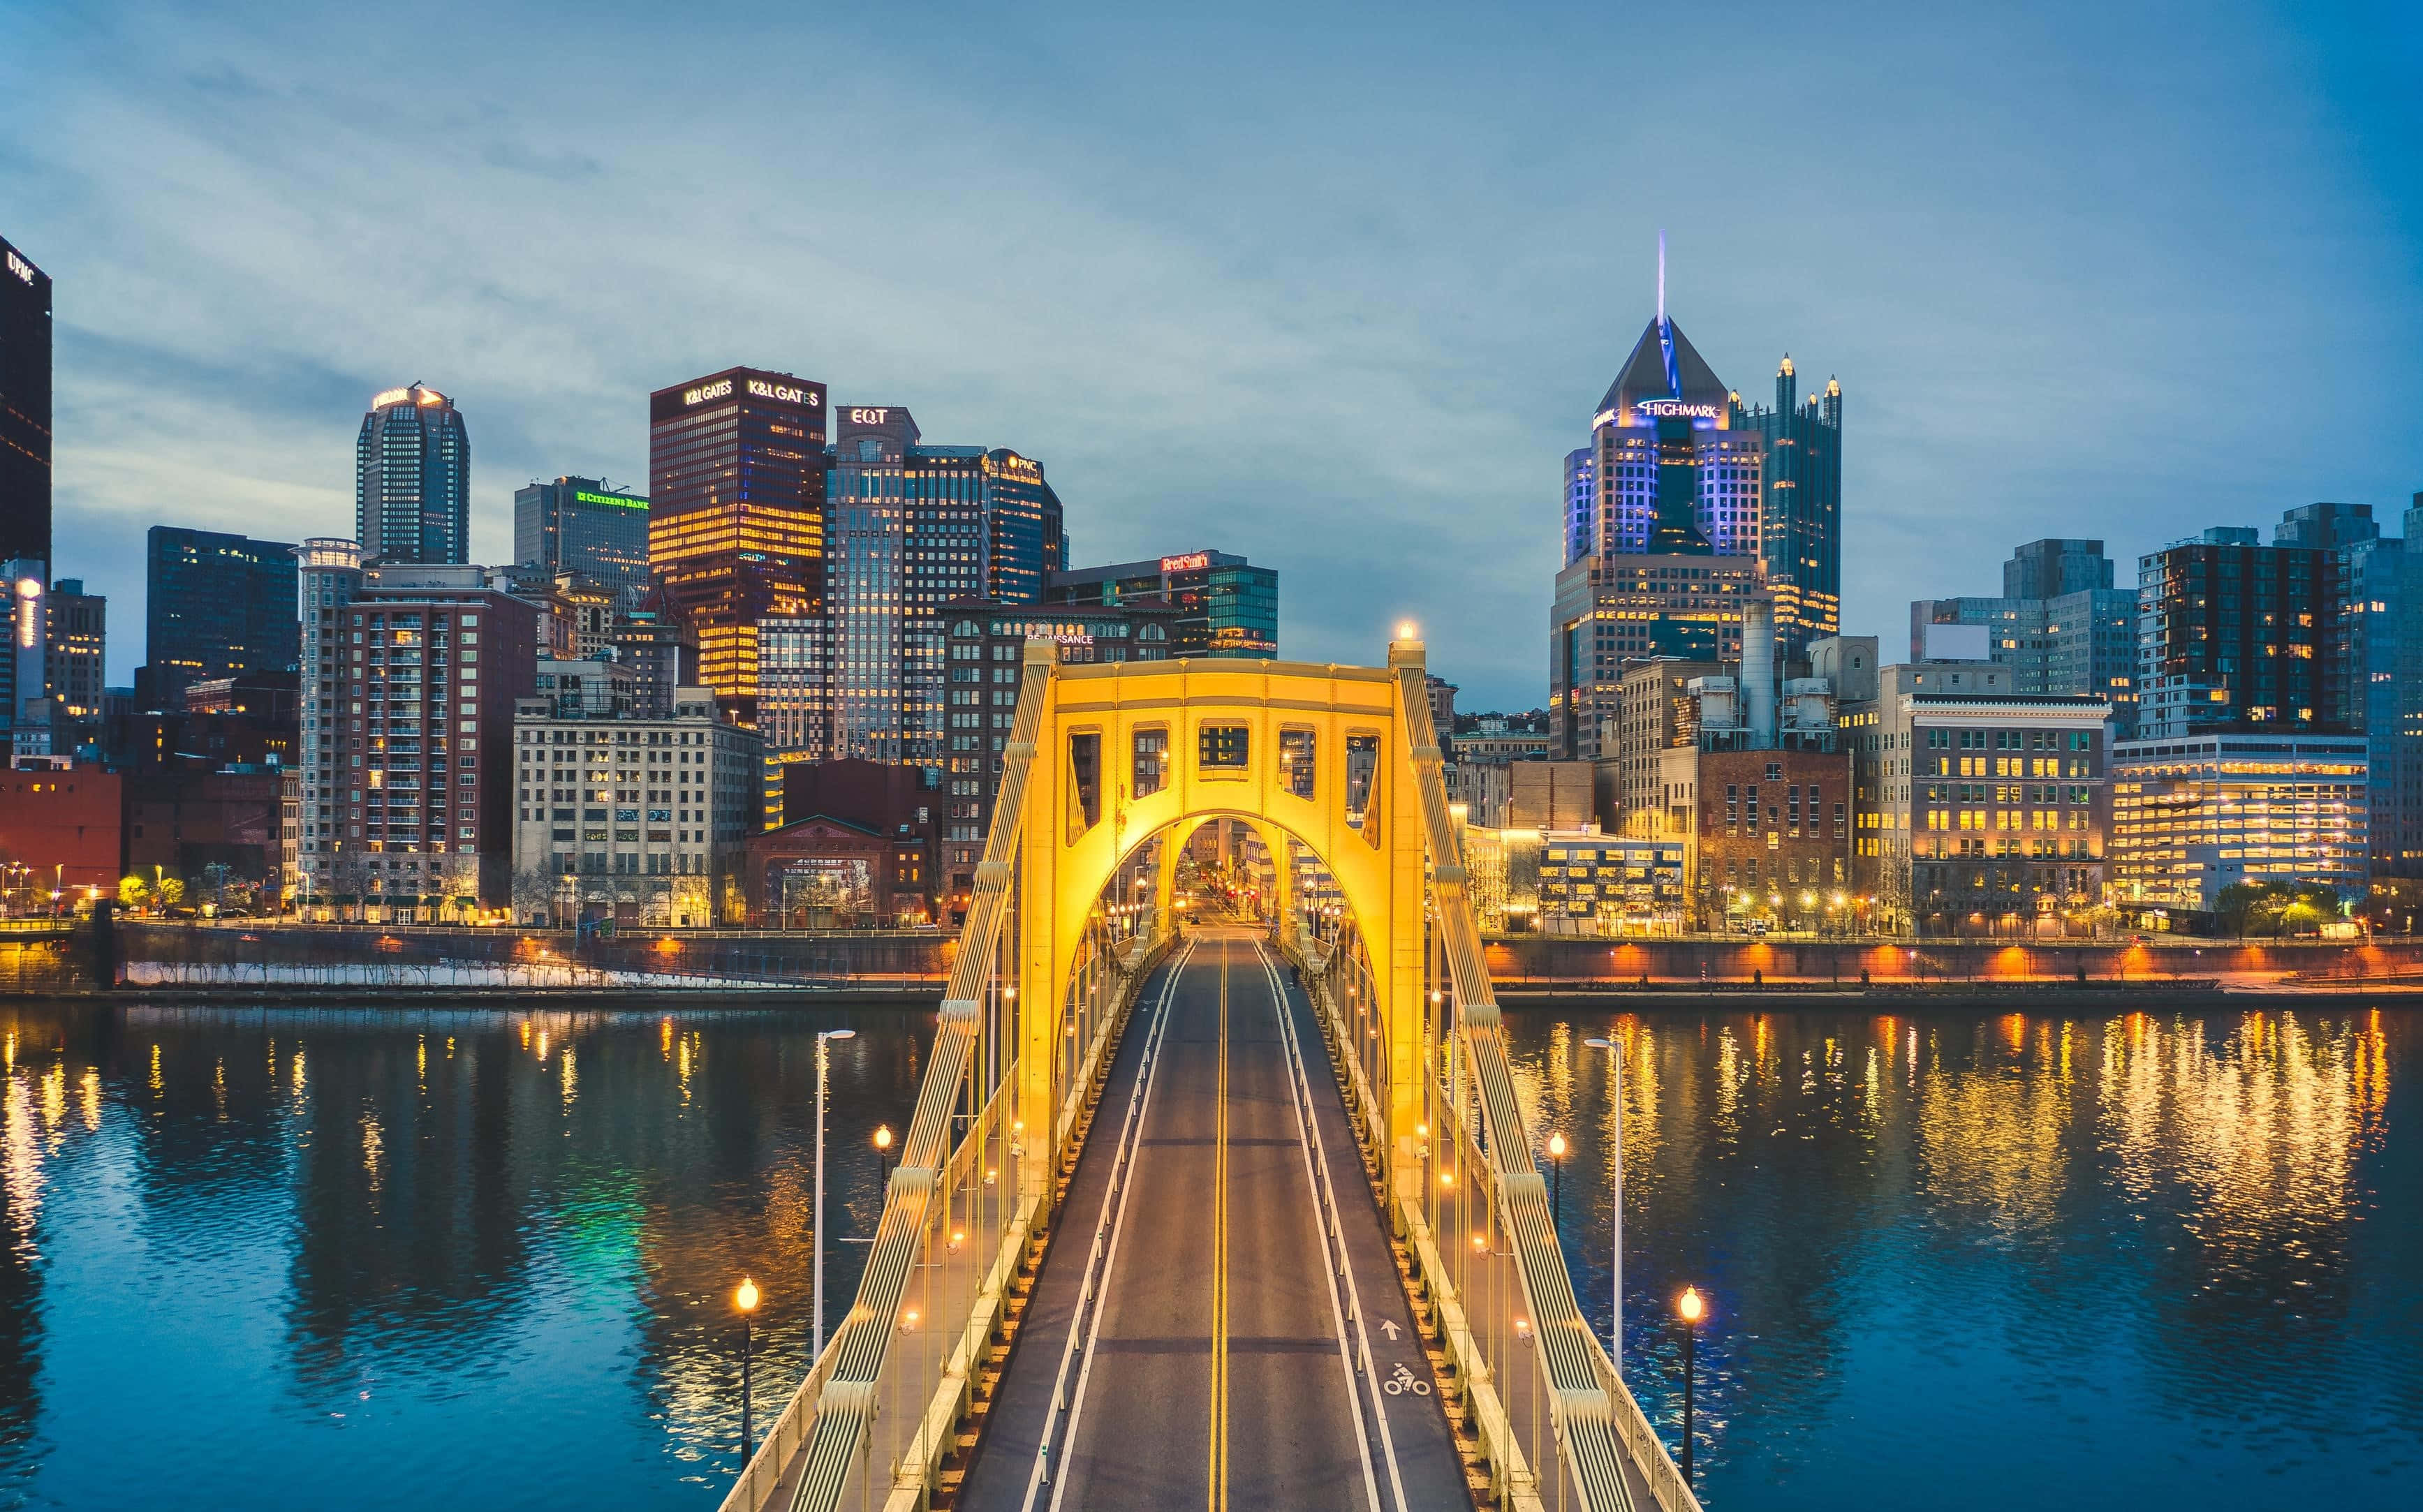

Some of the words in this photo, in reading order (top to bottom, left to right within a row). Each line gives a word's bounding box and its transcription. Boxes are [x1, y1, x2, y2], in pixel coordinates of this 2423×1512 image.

[7, 251, 34, 286] UPMC
[686, 389, 703, 405] K&L
[702, 380, 732, 400] GATES
[749, 380, 774, 398] K&L
[775, 386, 818, 406] GATES
[852, 409, 888, 424] EQT
[1646, 403, 1716, 418] HIGHMARK
[1019, 459, 1037, 471] PNC
[626, 498, 650, 510] BANK
[1162, 556, 1184, 570] Reed
[1184, 554, 1207, 568] Smith
